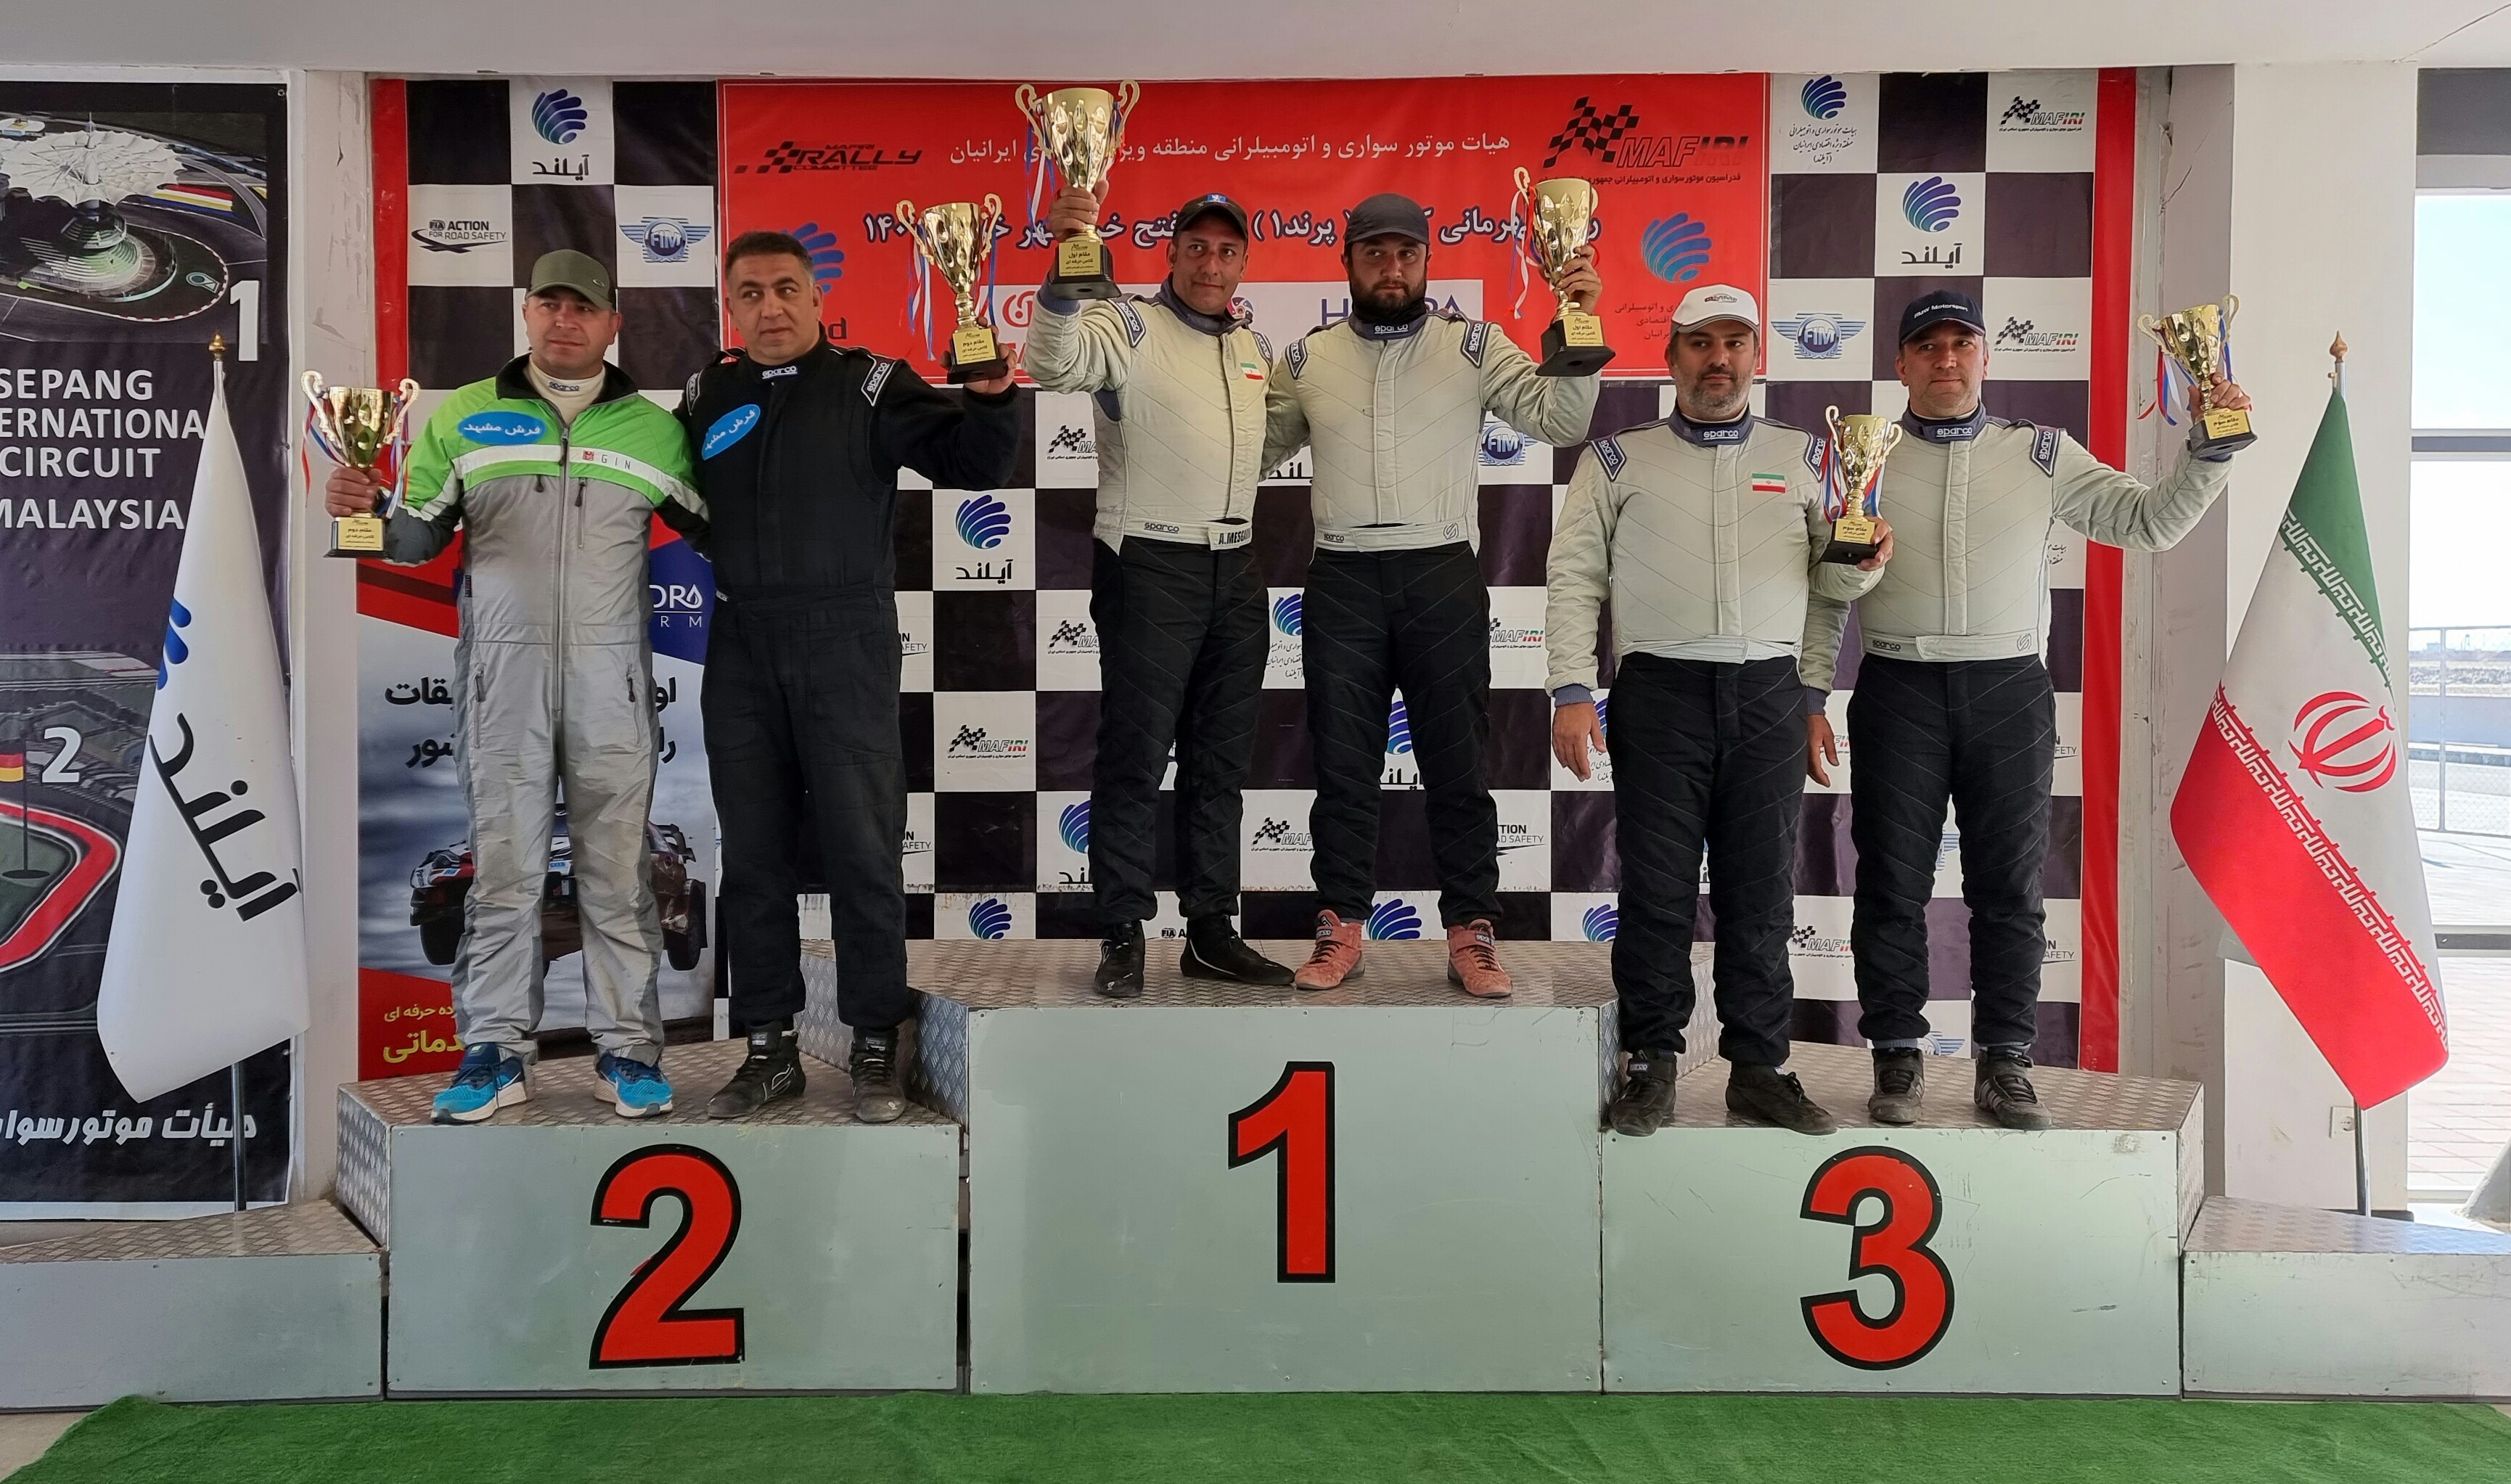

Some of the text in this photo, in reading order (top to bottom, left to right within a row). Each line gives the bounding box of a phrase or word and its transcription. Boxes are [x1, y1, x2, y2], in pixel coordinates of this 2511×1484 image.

[795, 150, 922, 165] RALLY
[950, 139, 1016, 163] ایرانیان
[1152, 138, 1208, 156] منطقه
[1214, 134, 1315, 161] اتومبیلرانی
[1322, 142, 1332, 158] و
[1338, 134, 1398, 158] سواری
[532, 155, 589, 181] آیلند
[447, 221, 489, 231] ACTION
[1441, 208, 1527, 242] هرمانی
[650, 229, 681, 250] FIM
[1901, 243, 1962, 268] آیلند
[230, 280, 260, 361] 1
[1804, 327, 1835, 345] FIM
[762, 365, 798, 378] sparco
[867, 362, 888, 392] sparco
[0, 369, 152, 400] SEPANG
[0, 408, 204, 439] ERNATIONA
[463, 421, 541, 436] فرش مشهد
[729, 408, 755, 433] فرش
[1938, 426, 1973, 438] sparco
[1488, 434, 1520, 453] FIM
[1703, 429, 1739, 439] sparco
[2039, 431, 2052, 460] sparco
[0, 446, 161, 477] CIRCUIT
[1600, 440, 1618, 465] sparco
[1144, 522, 1179, 533] sparco
[956, 559, 1014, 584] آیلند
[1492, 630, 1544, 642] MAFIRI
[1872, 639, 1901, 652] sparco
[41, 726, 83, 784] 2
[978, 740, 1028, 752] MAFIRI
[1282, 833, 1312, 845] MAF
[1497, 824, 1527, 834] TION
[1161, 928, 1176, 938] FIA
[384, 1006, 400, 1022] ای
[404, 1004, 435, 1020] حرفه
[383, 1030, 465, 1064] دماتی
[0, 1110, 153, 1146] موتورسوا
[1228, 1060, 1335, 1283] 1
[590, 1144, 745, 1370] 2
[1800, 1145, 1954, 1372] 3
